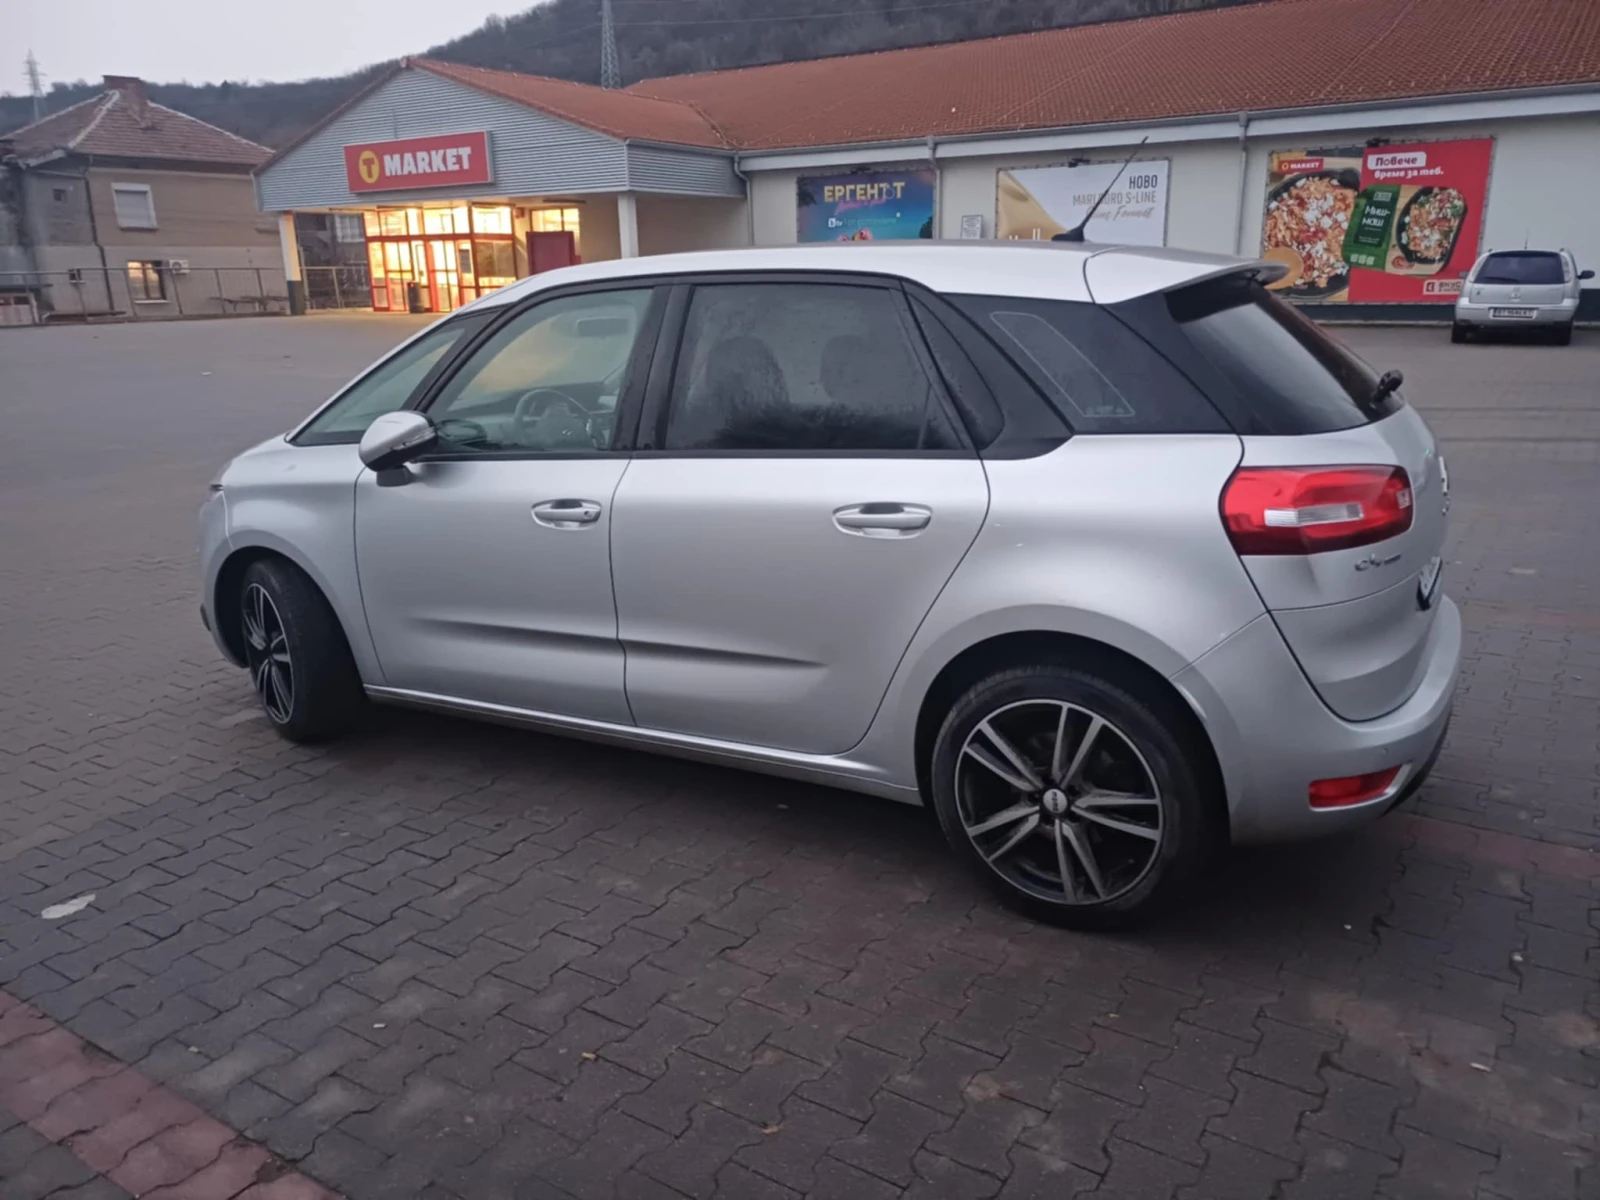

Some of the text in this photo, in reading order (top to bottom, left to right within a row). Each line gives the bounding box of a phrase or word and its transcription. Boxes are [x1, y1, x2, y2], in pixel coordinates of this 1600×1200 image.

[383, 146, 472, 177] MARKET
[1290, 161, 1320, 169] MARKET
[1375, 156, 1418, 167] Повече
[1374, 165, 1445, 180] време за теб.
[1129, 174, 1158, 190] НОВО
